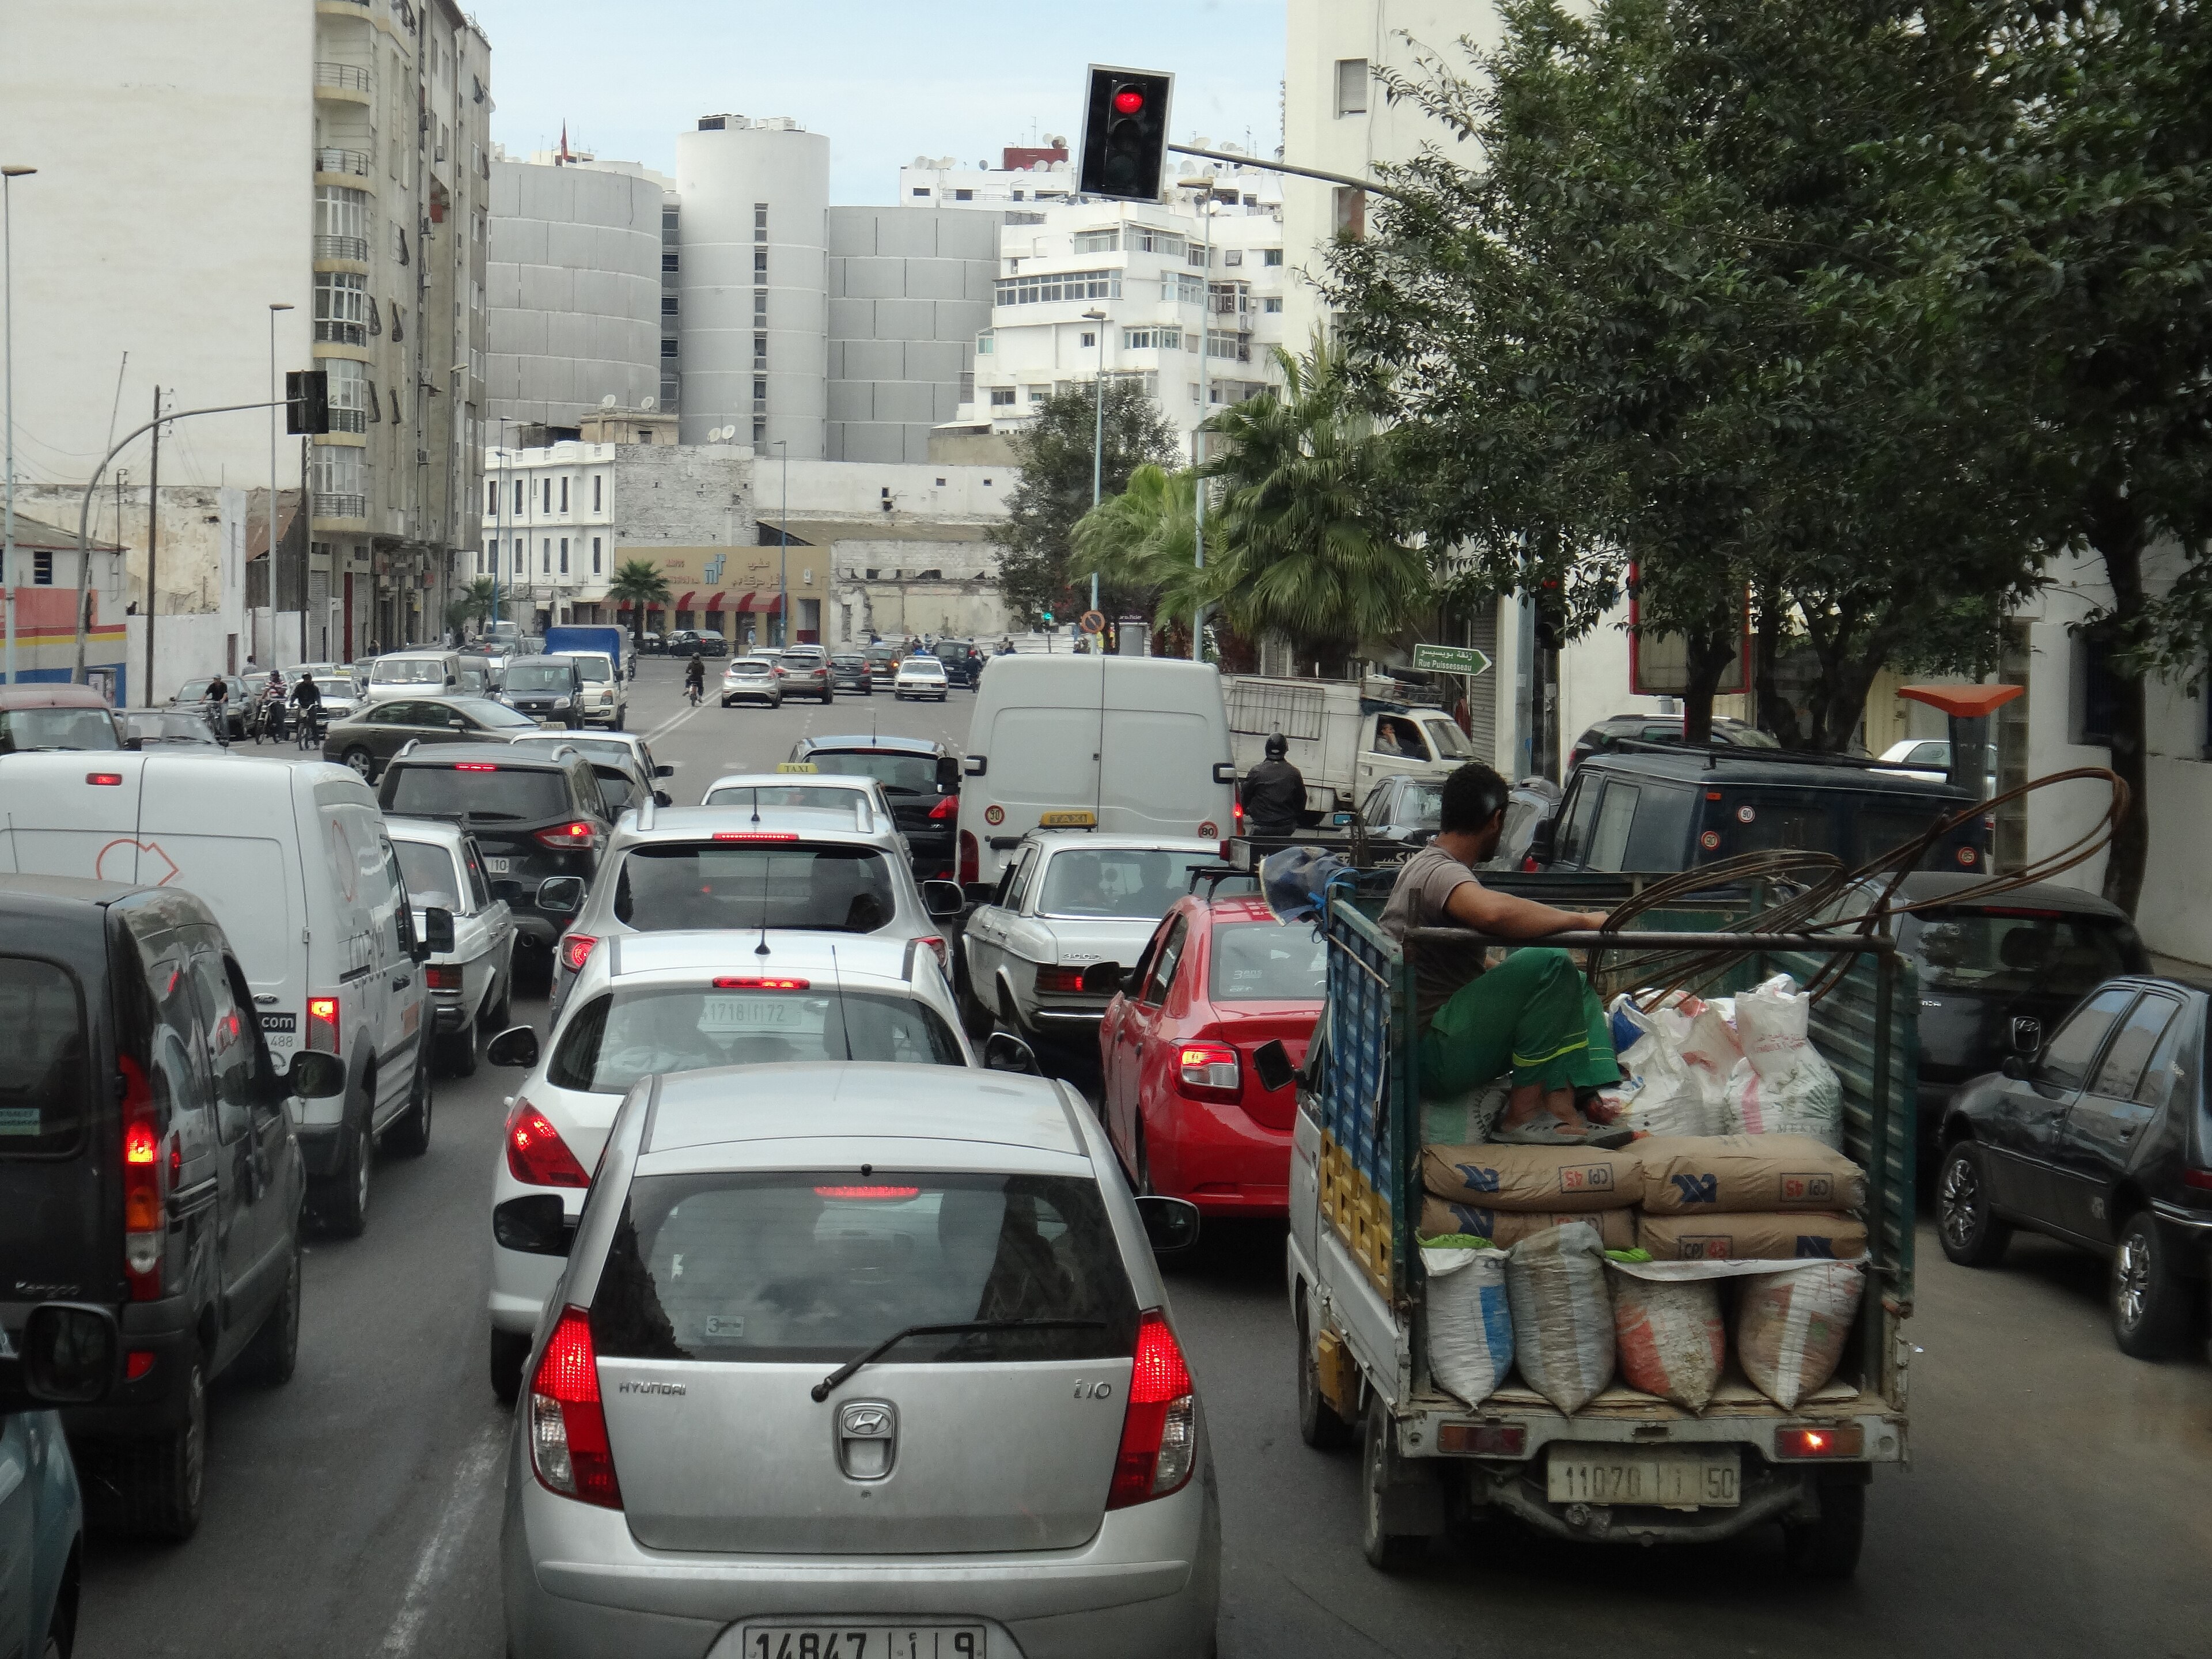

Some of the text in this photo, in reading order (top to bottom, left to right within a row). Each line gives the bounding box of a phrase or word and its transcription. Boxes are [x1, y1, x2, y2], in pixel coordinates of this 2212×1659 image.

[1418, 658, 1472, 671] Rue Puissesseau
[1051, 815, 1086, 824] TAXI
[1742, 809, 1751, 819] 90
[1202, 827, 1214, 836] 80
[494, 859, 506, 871] 10
[270, 1035, 293, 1048] 488
[1565, 1170, 1583, 1187] 45
[1786, 1179, 1804, 1197] 45
[1709, 1241, 1727, 1258] 45
[619, 1381, 687, 1396] HYUNDAI
[1073, 1378, 1112, 1399] i10
[1565, 1466, 1641, 1497] 11070
[1707, 1467, 1734, 1499] 50
[755, 1632, 867, 1659] 14847
[953, 1631, 975, 1659] 9
